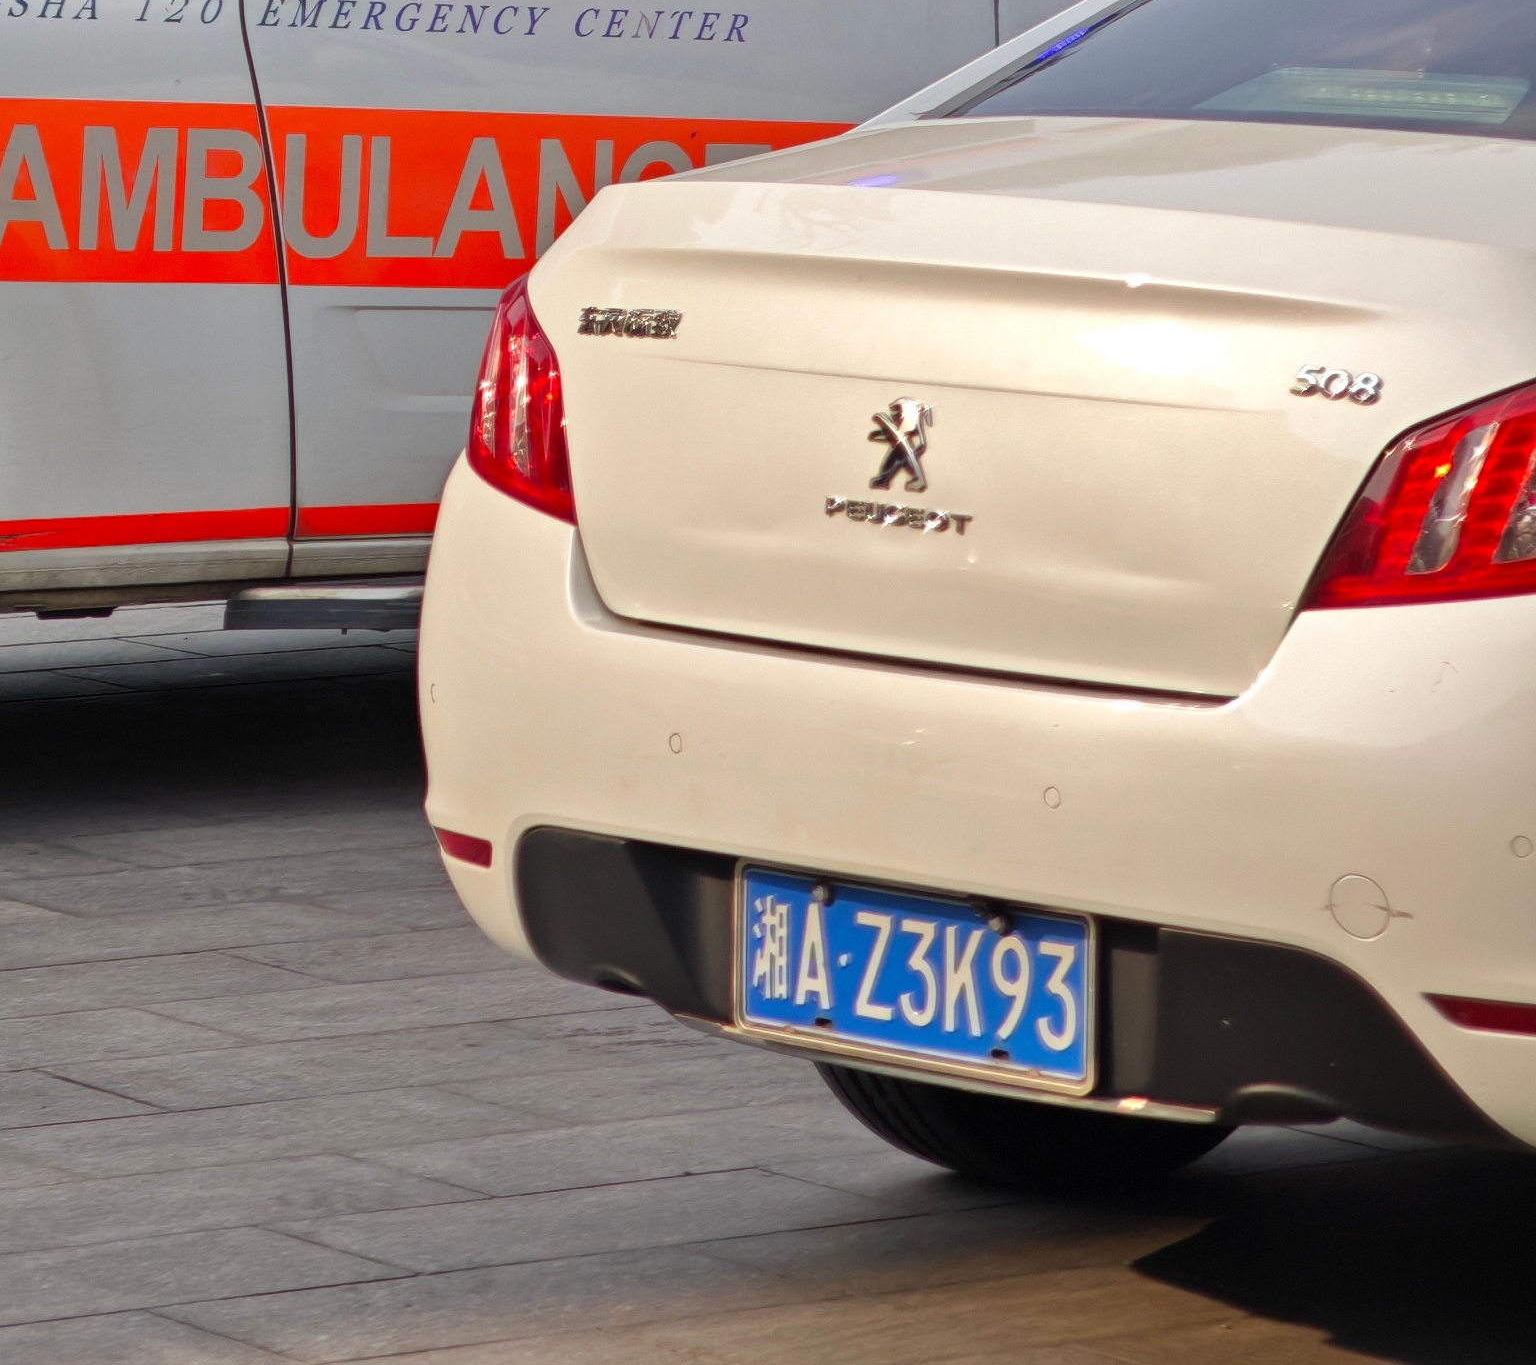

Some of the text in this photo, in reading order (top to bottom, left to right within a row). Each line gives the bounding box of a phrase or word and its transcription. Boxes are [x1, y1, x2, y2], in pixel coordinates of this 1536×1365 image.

[574, 8, 750, 43] CENTER
[1289, 364, 1384, 406] 508
[825, 496, 973, 536] PEUGEOT
